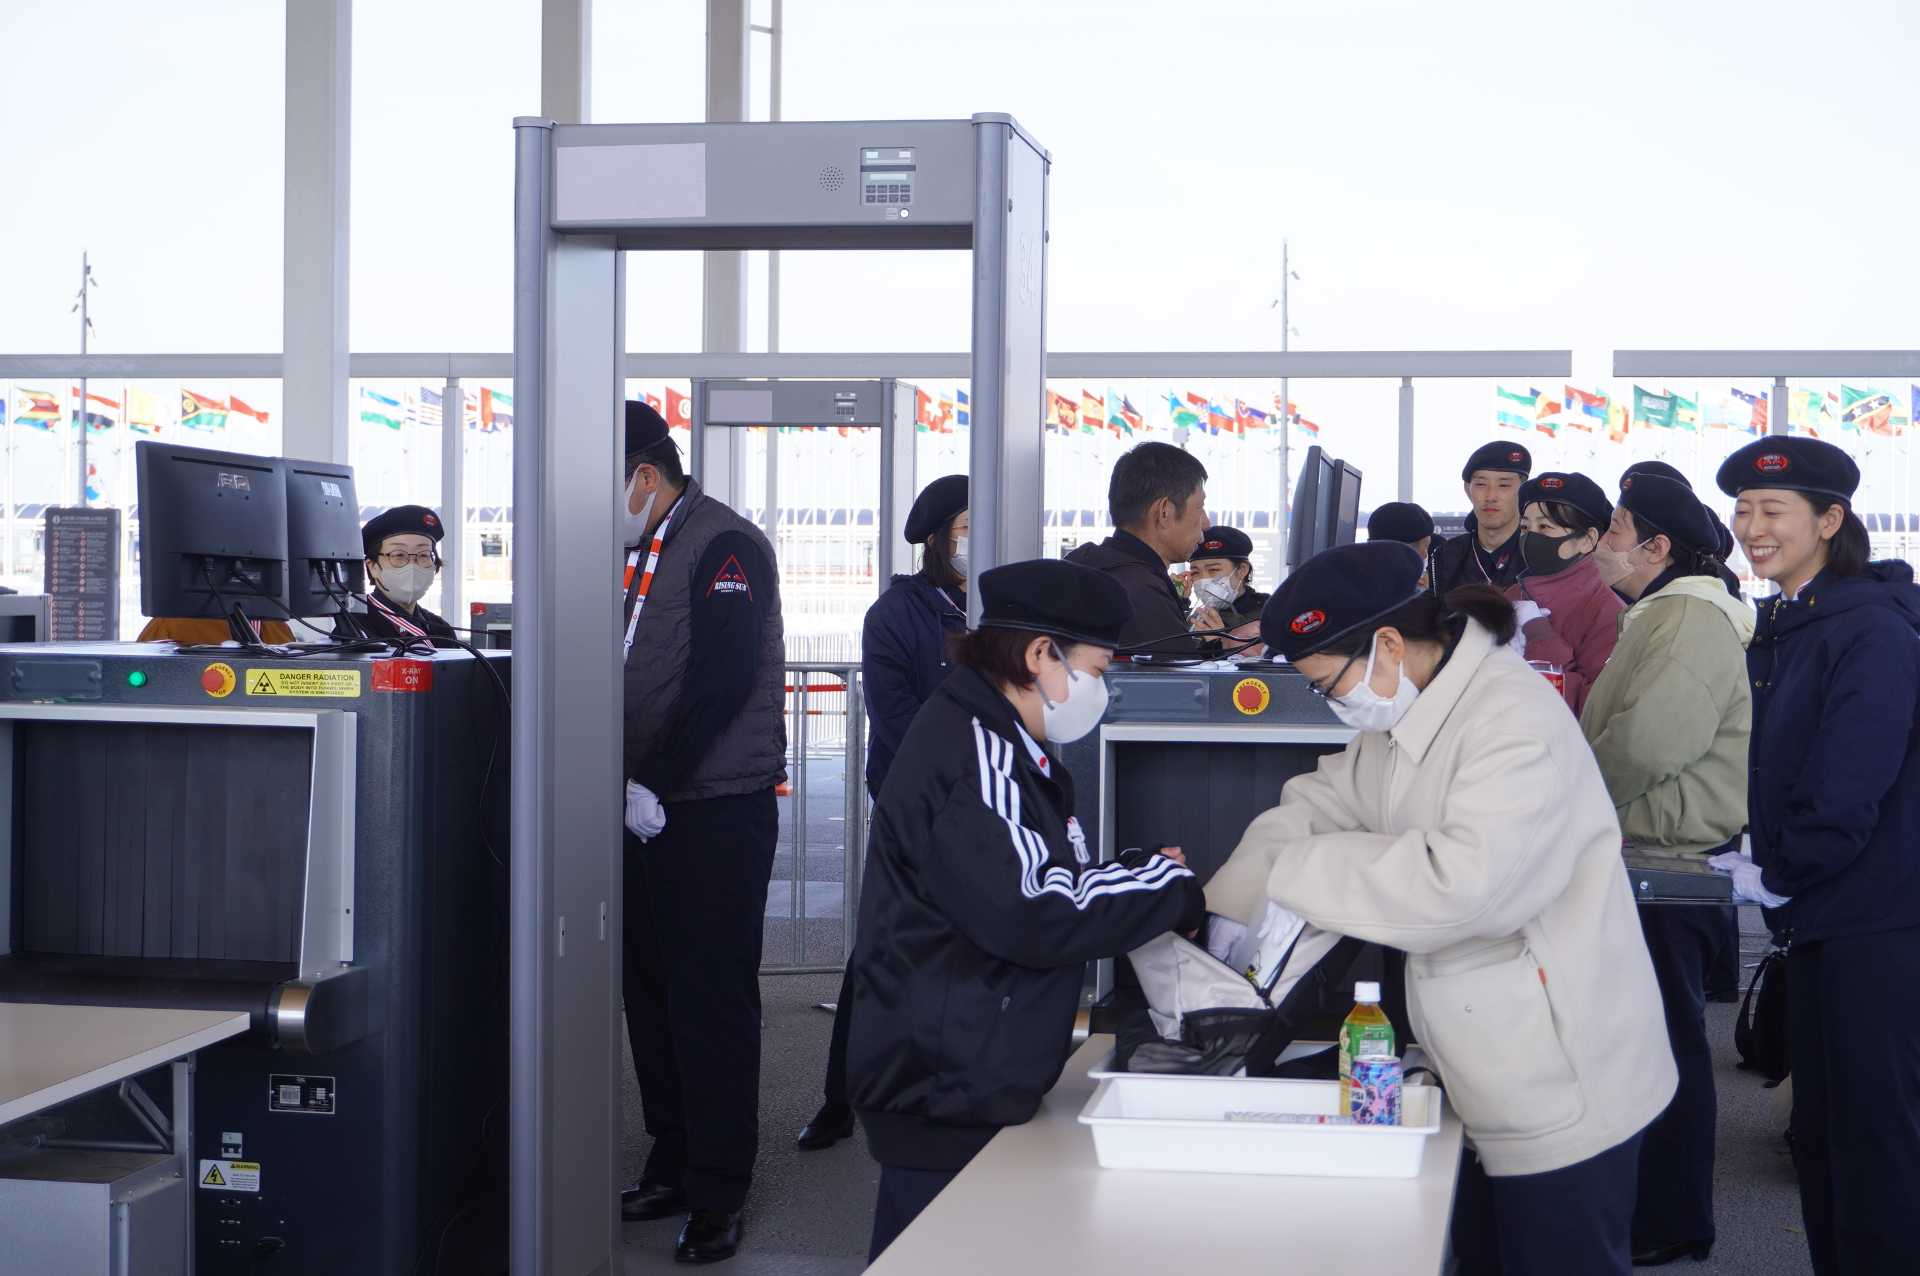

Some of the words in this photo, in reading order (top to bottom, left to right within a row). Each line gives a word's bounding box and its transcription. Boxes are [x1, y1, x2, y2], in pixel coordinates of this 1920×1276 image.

[714, 582, 735, 590] RISING
[735, 583, 747, 591] SUN
[405, 676, 418, 684] ON
